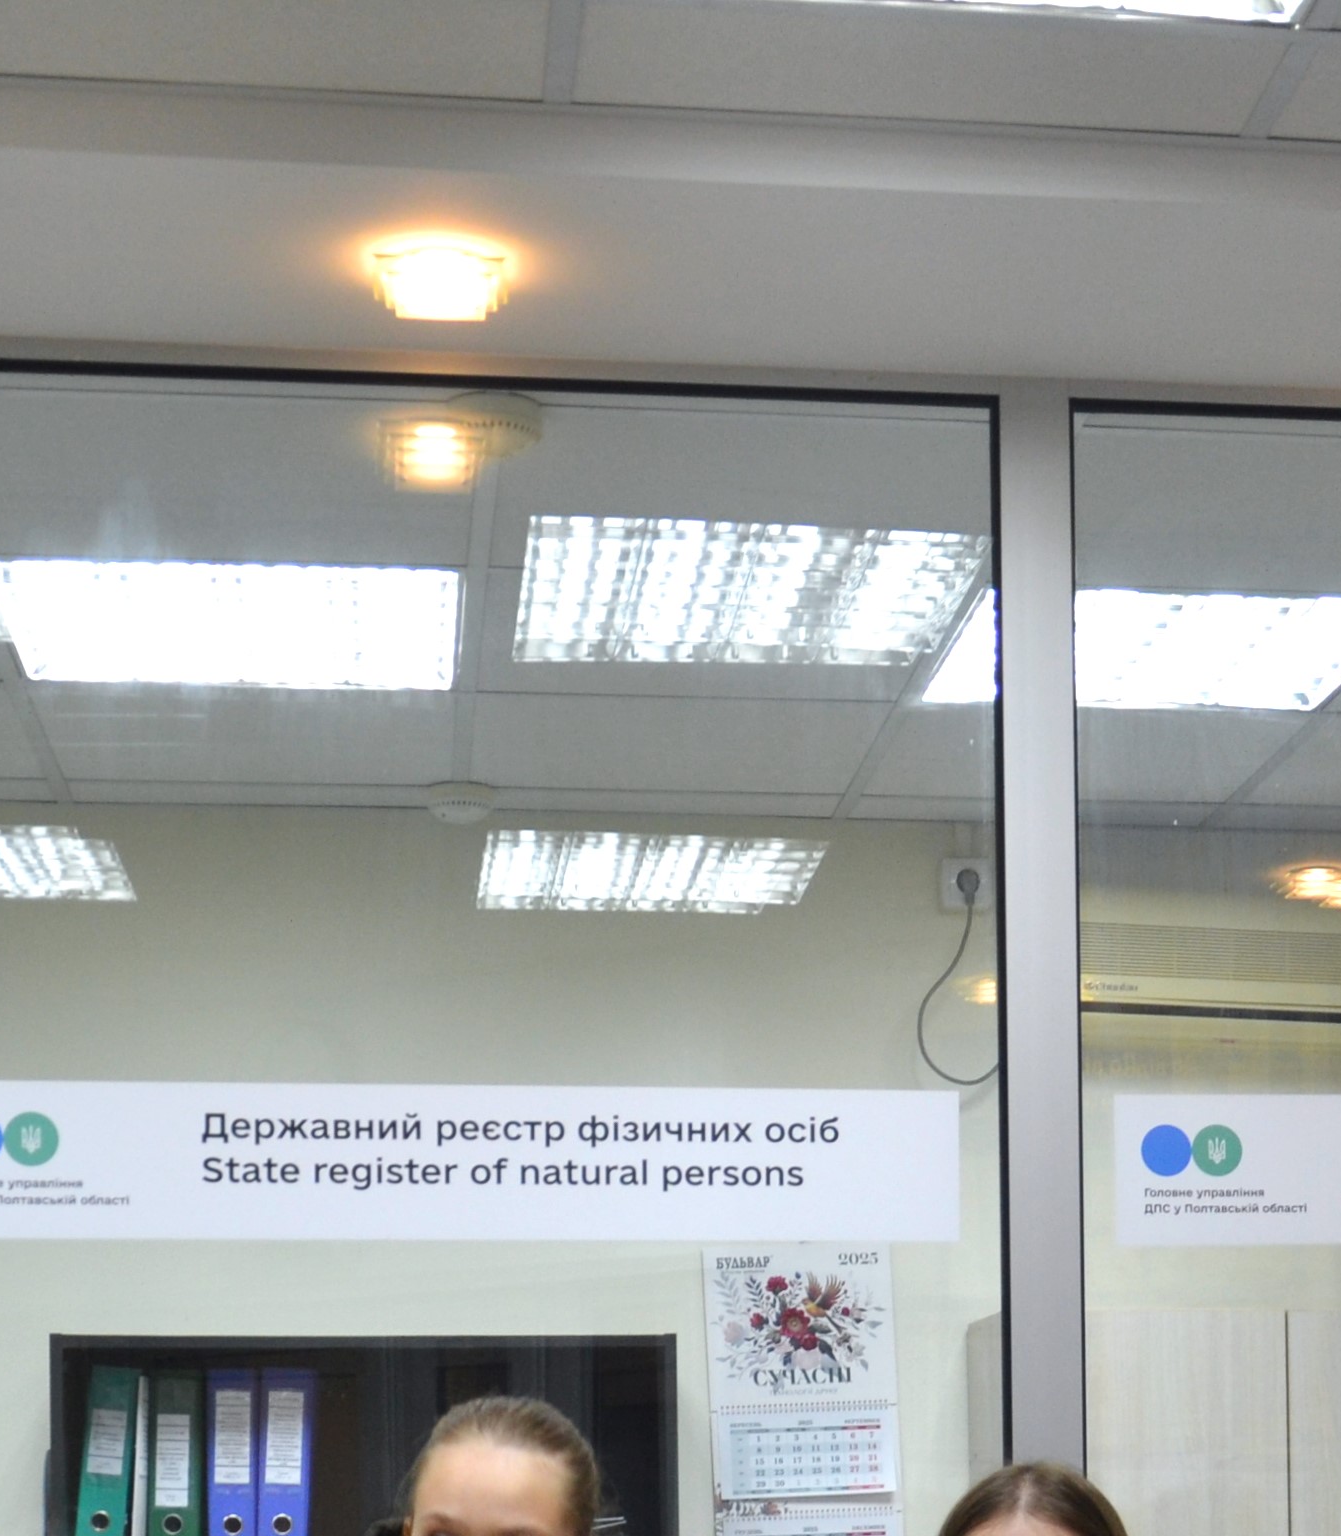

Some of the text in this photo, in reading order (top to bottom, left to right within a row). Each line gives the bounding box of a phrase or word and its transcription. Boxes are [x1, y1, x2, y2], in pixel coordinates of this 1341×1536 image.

[202, 1112, 840, 1147] Державний реєстр фізичних осіб
[202, 1156, 805, 1192] State register of natural persons
[8, 1178, 84, 1191] управління
[1144, 1187, 1265, 1200] Головне управління
[80, 1195, 130, 1206] області
[1144, 1203, 1308, 1215] ДПС у Полтавській області
[716, 1256, 770, 1269] БУЛЬВАР
[838, 1252, 878, 1265] 2025
[753, 1367, 852, 1386] СУЧАСНІ
